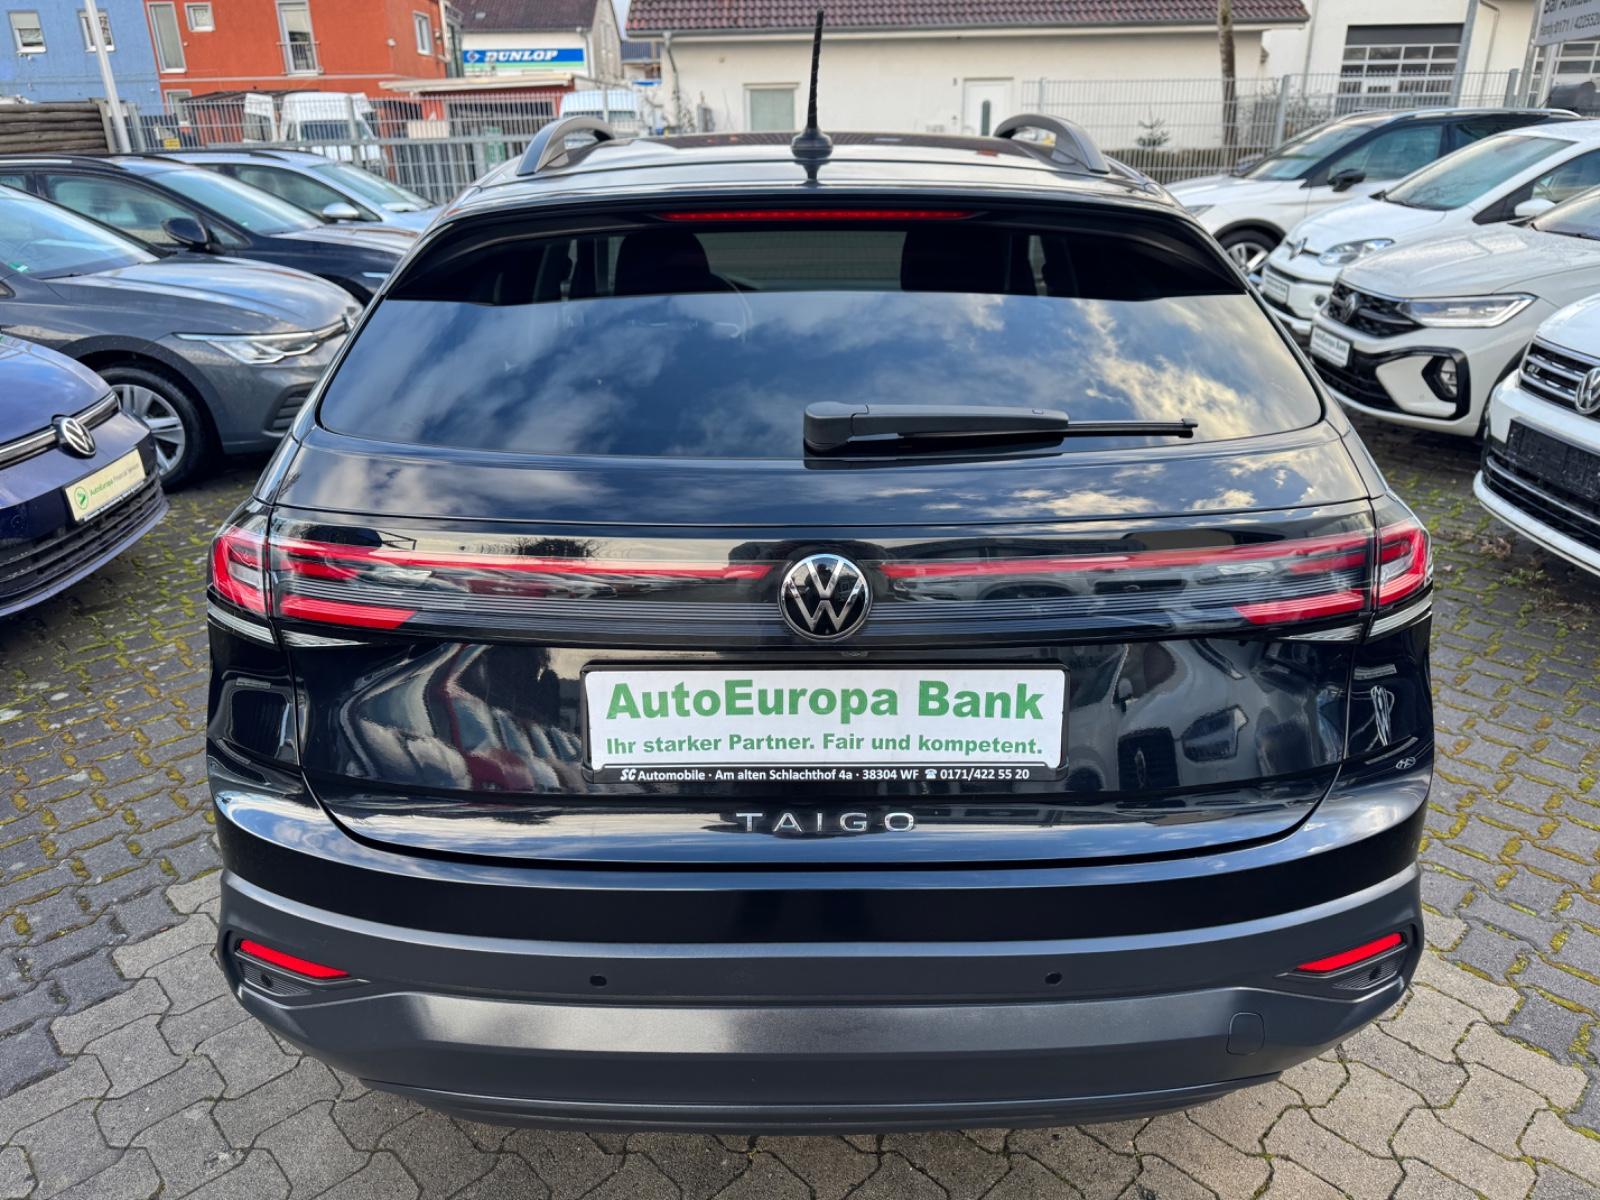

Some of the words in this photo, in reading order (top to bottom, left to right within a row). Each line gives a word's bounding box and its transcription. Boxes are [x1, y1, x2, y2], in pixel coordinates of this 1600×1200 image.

[484, 49, 559, 62] DUNLOP
[606, 679, 898, 725] AutoEuropa
[918, 680, 1044, 720] Bank
[607, 738, 635, 755] Ihr
[643, 736, 722, 754] starker
[729, 735, 815, 751] Partner.
[823, 733, 865, 751] Fair
[871, 734, 912, 751] und
[918, 735, 1043, 756] kompetent.
[637, 768, 706, 781] Automobile
[715, 769, 735, 780] Am
[738, 768, 766, 780] alten
[769, 768, 837, 781] Schlachthof
[838, 769, 853, 781] 4a
[862, 769, 898, 780] 38304
[900, 769, 920, 780] WF
[940, 768, 996, 782] 0171/422
[998, 769, 1013, 780] 55
[1014, 768, 1030, 780] 20
[736, 812, 917, 834] TAIGO
